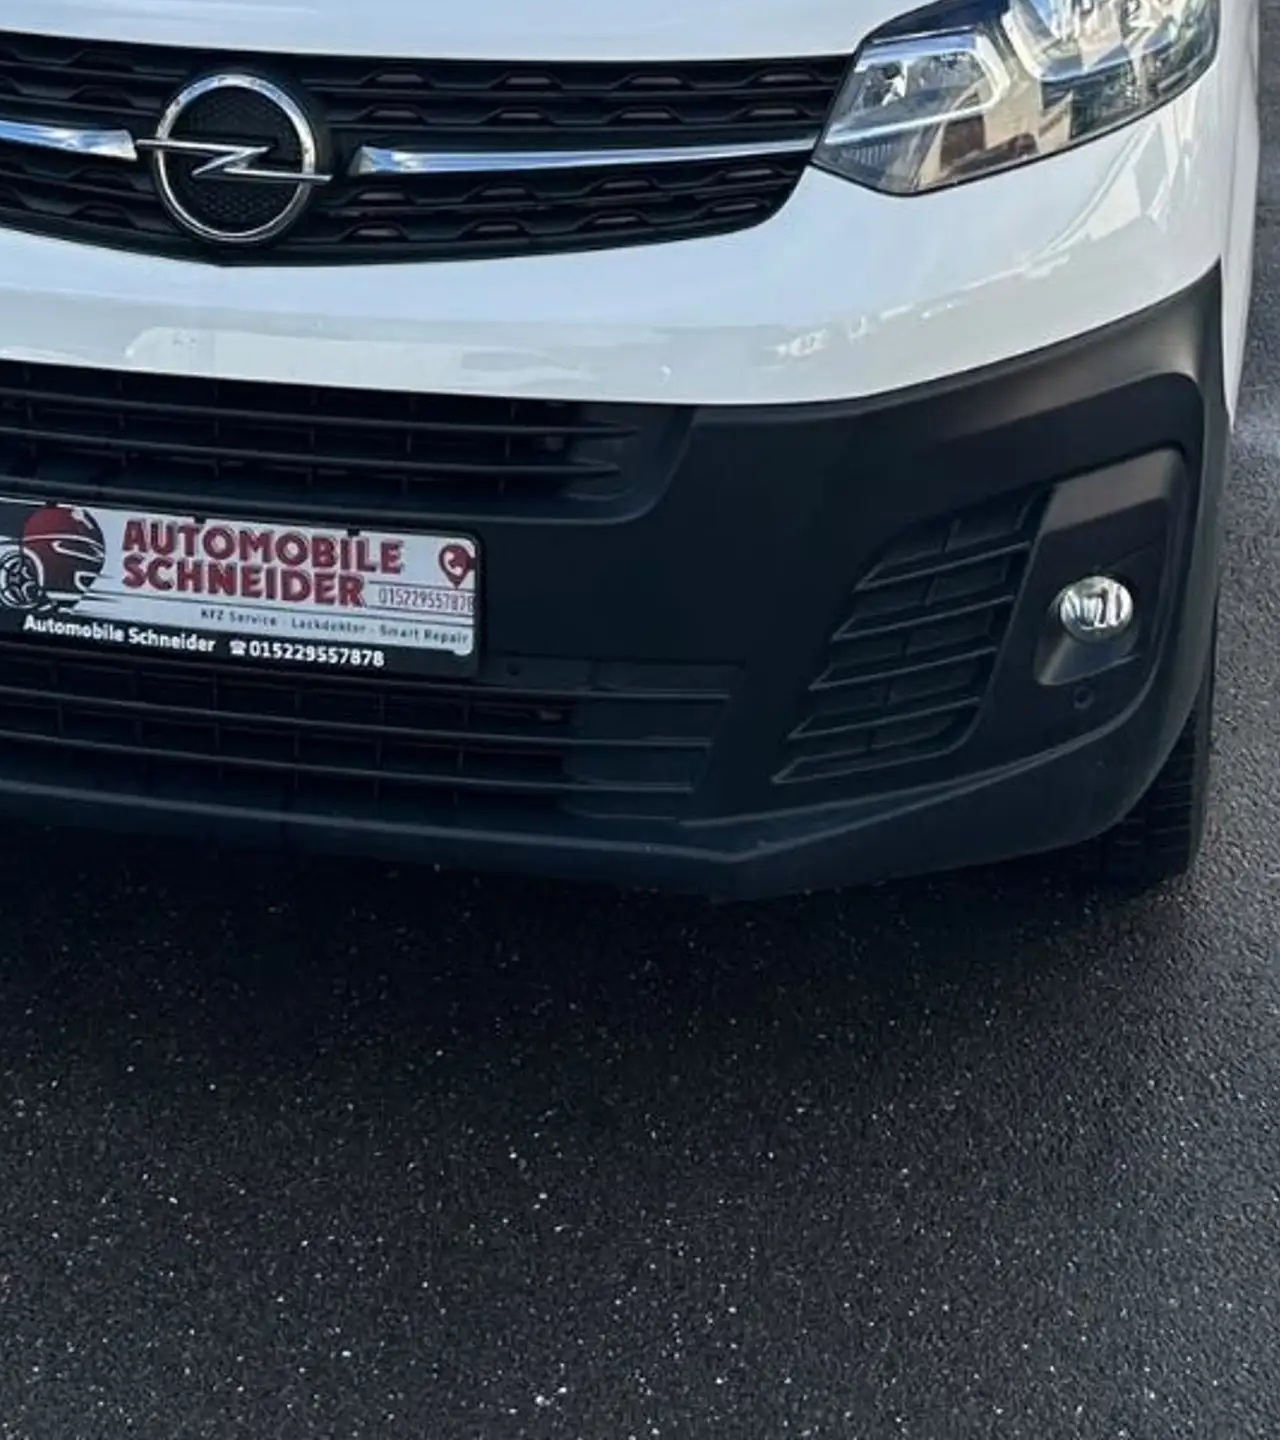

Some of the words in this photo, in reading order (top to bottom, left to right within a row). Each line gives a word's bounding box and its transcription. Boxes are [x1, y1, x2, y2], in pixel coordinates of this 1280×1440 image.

[122, 518, 404, 574] AUTOMOBILE
[122, 553, 367, 608] SCHNEIDER
[23, 614, 125, 642] Automobile
[128, 627, 216, 652] Schneider
[249, 640, 385, 667] 015229557878
[200, 608, 223, 620] KFZ
[229, 611, 277, 625] Service
[380, 624, 418, 637] Smart
[423, 629, 469, 645] Repair
